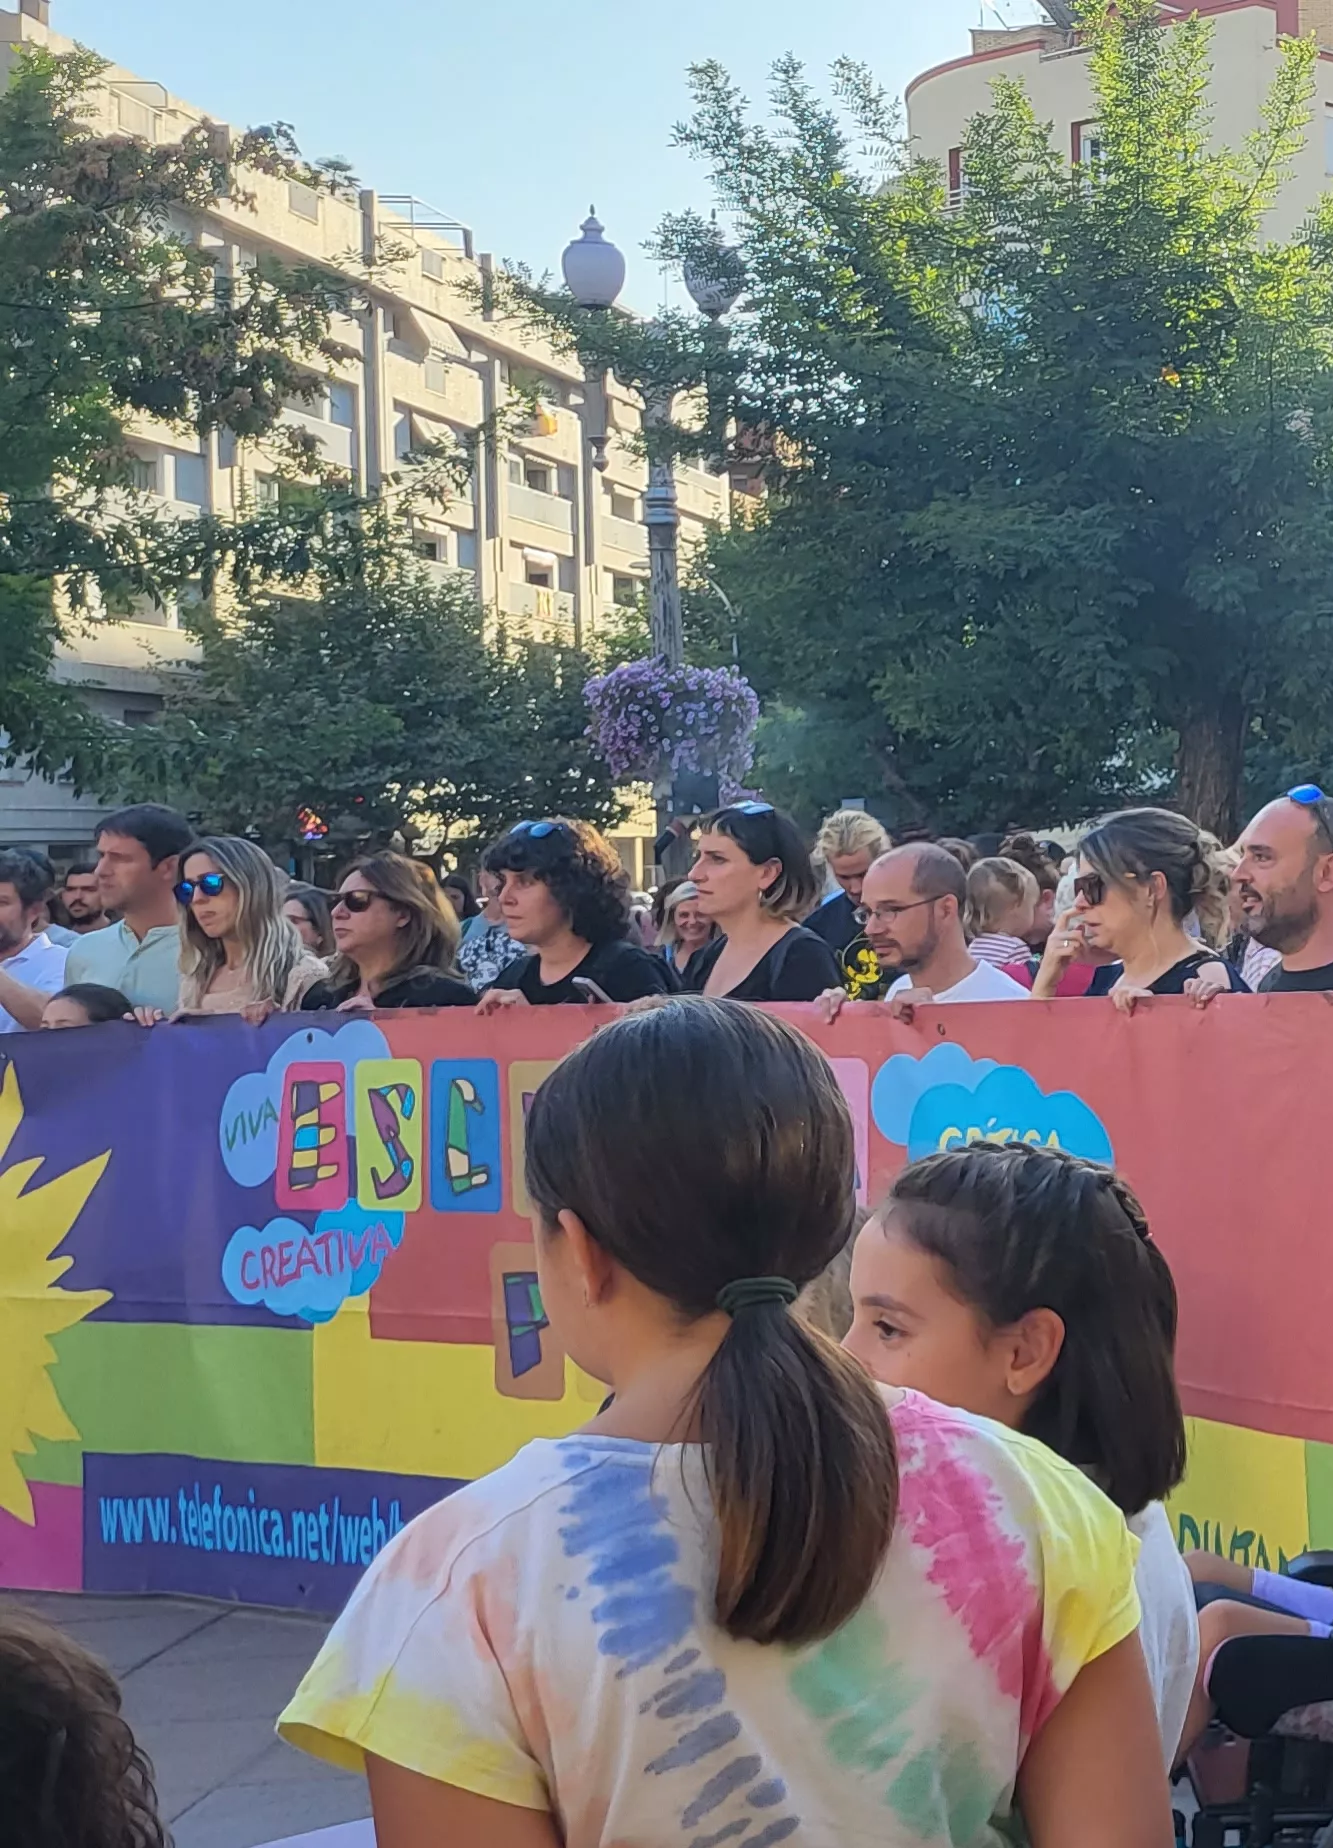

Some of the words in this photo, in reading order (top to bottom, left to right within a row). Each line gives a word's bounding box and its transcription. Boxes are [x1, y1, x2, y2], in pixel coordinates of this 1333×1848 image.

[225, 1097, 279, 1151] VIVA
[289, 1079, 535, 1200] ESC
[240, 1222, 400, 1290] CREATIVA
[99, 1481, 404, 1566] www.telefonica.net/web/
